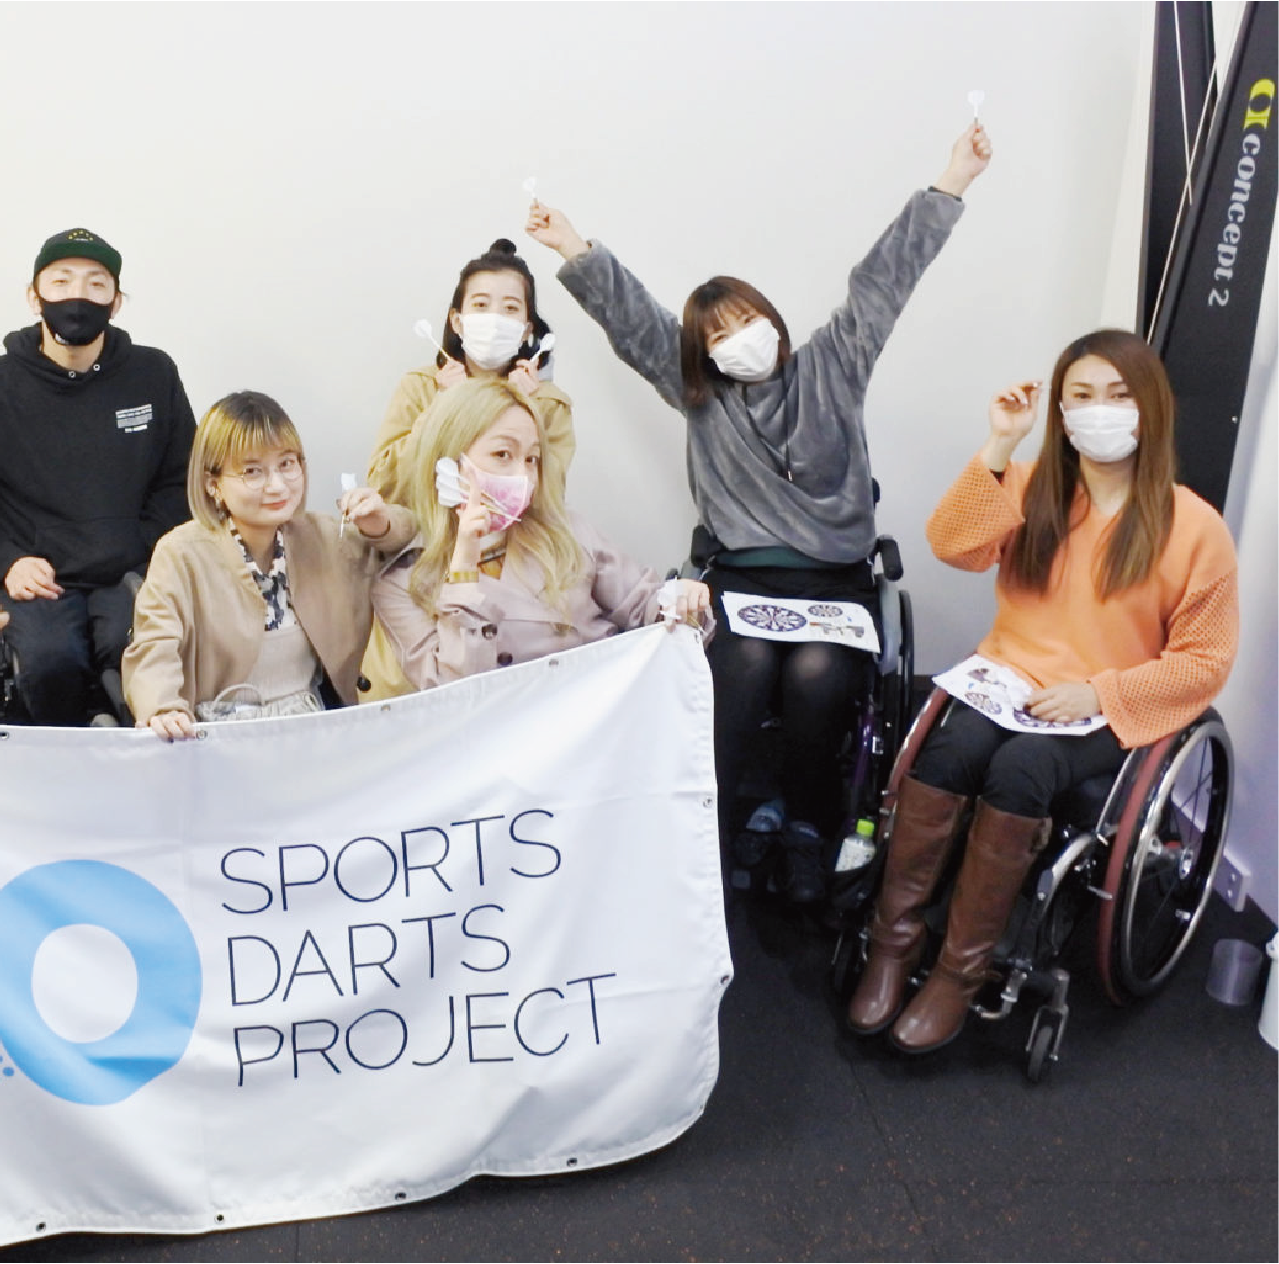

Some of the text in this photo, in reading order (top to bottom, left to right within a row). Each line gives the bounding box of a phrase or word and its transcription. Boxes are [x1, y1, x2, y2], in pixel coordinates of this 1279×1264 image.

[1207, 132, 1261, 307] concept 2
[220, 808, 562, 915] SPORTS
[227, 904, 511, 1007] DARTS
[232, 972, 618, 1088] PROJECT
